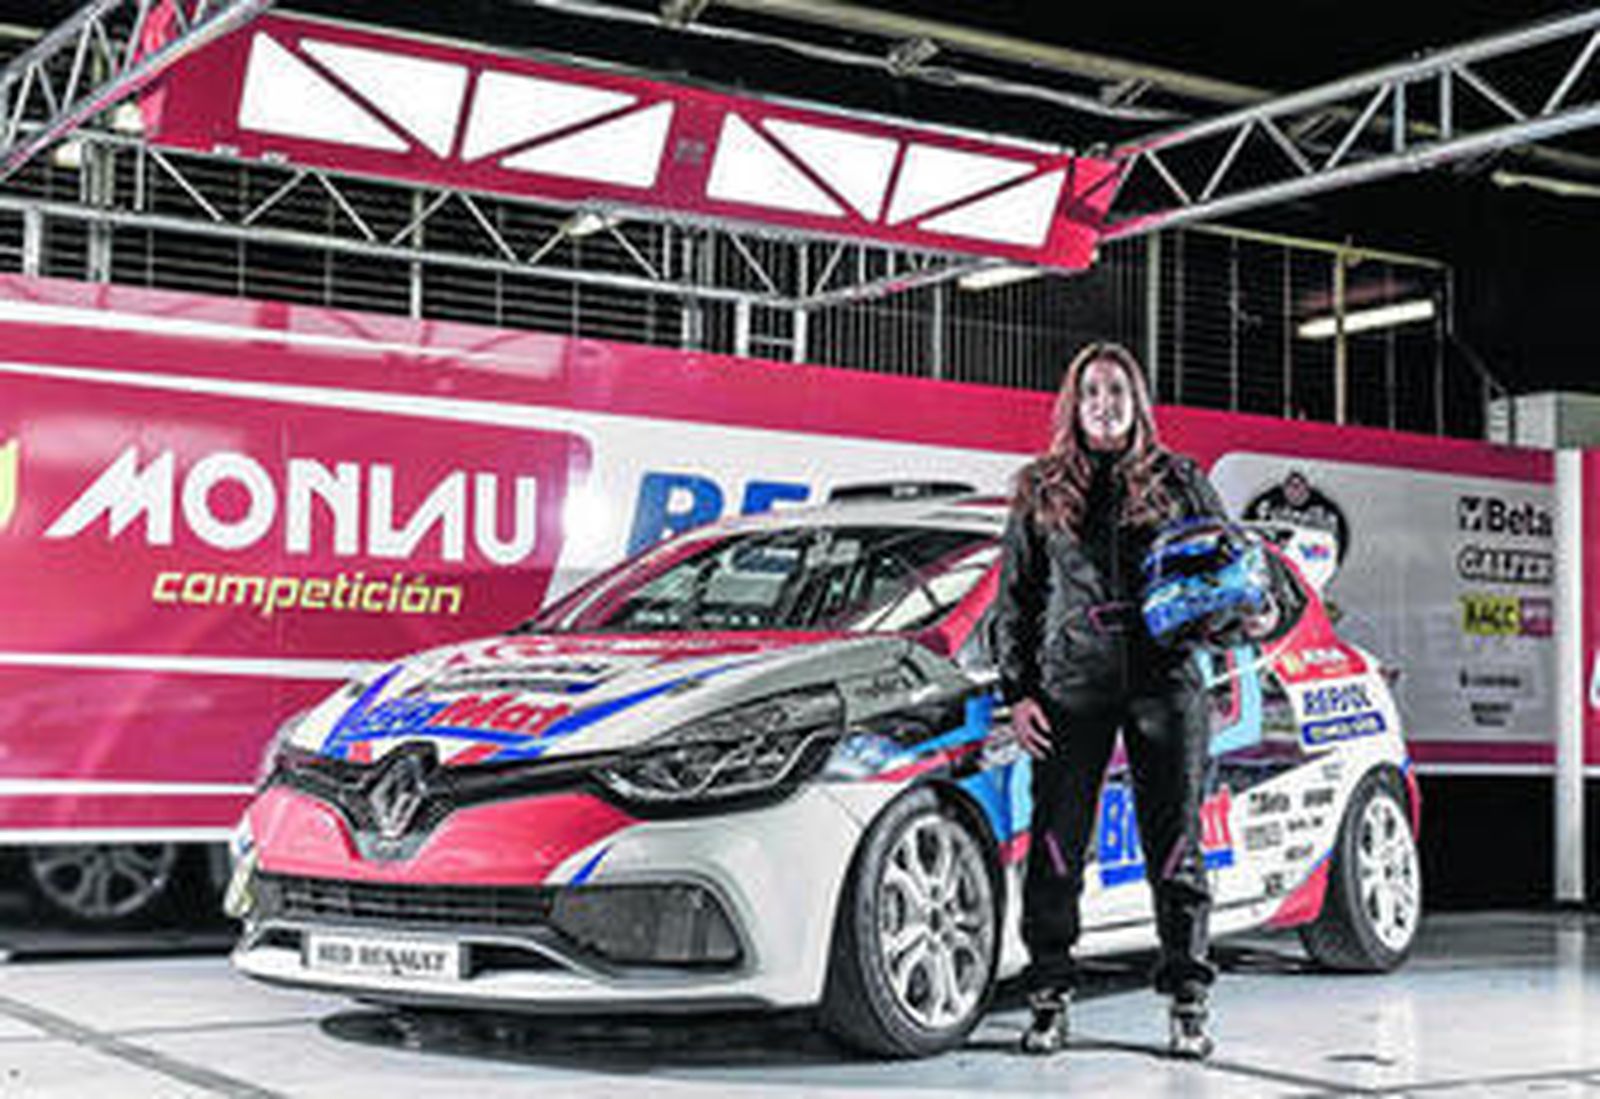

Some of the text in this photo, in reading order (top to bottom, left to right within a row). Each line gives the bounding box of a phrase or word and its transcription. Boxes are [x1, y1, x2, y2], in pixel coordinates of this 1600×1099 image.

[44, 446, 537, 565] MONLAU
[1487, 498, 1553, 537] Beta
[152, 570, 463, 616] competición
